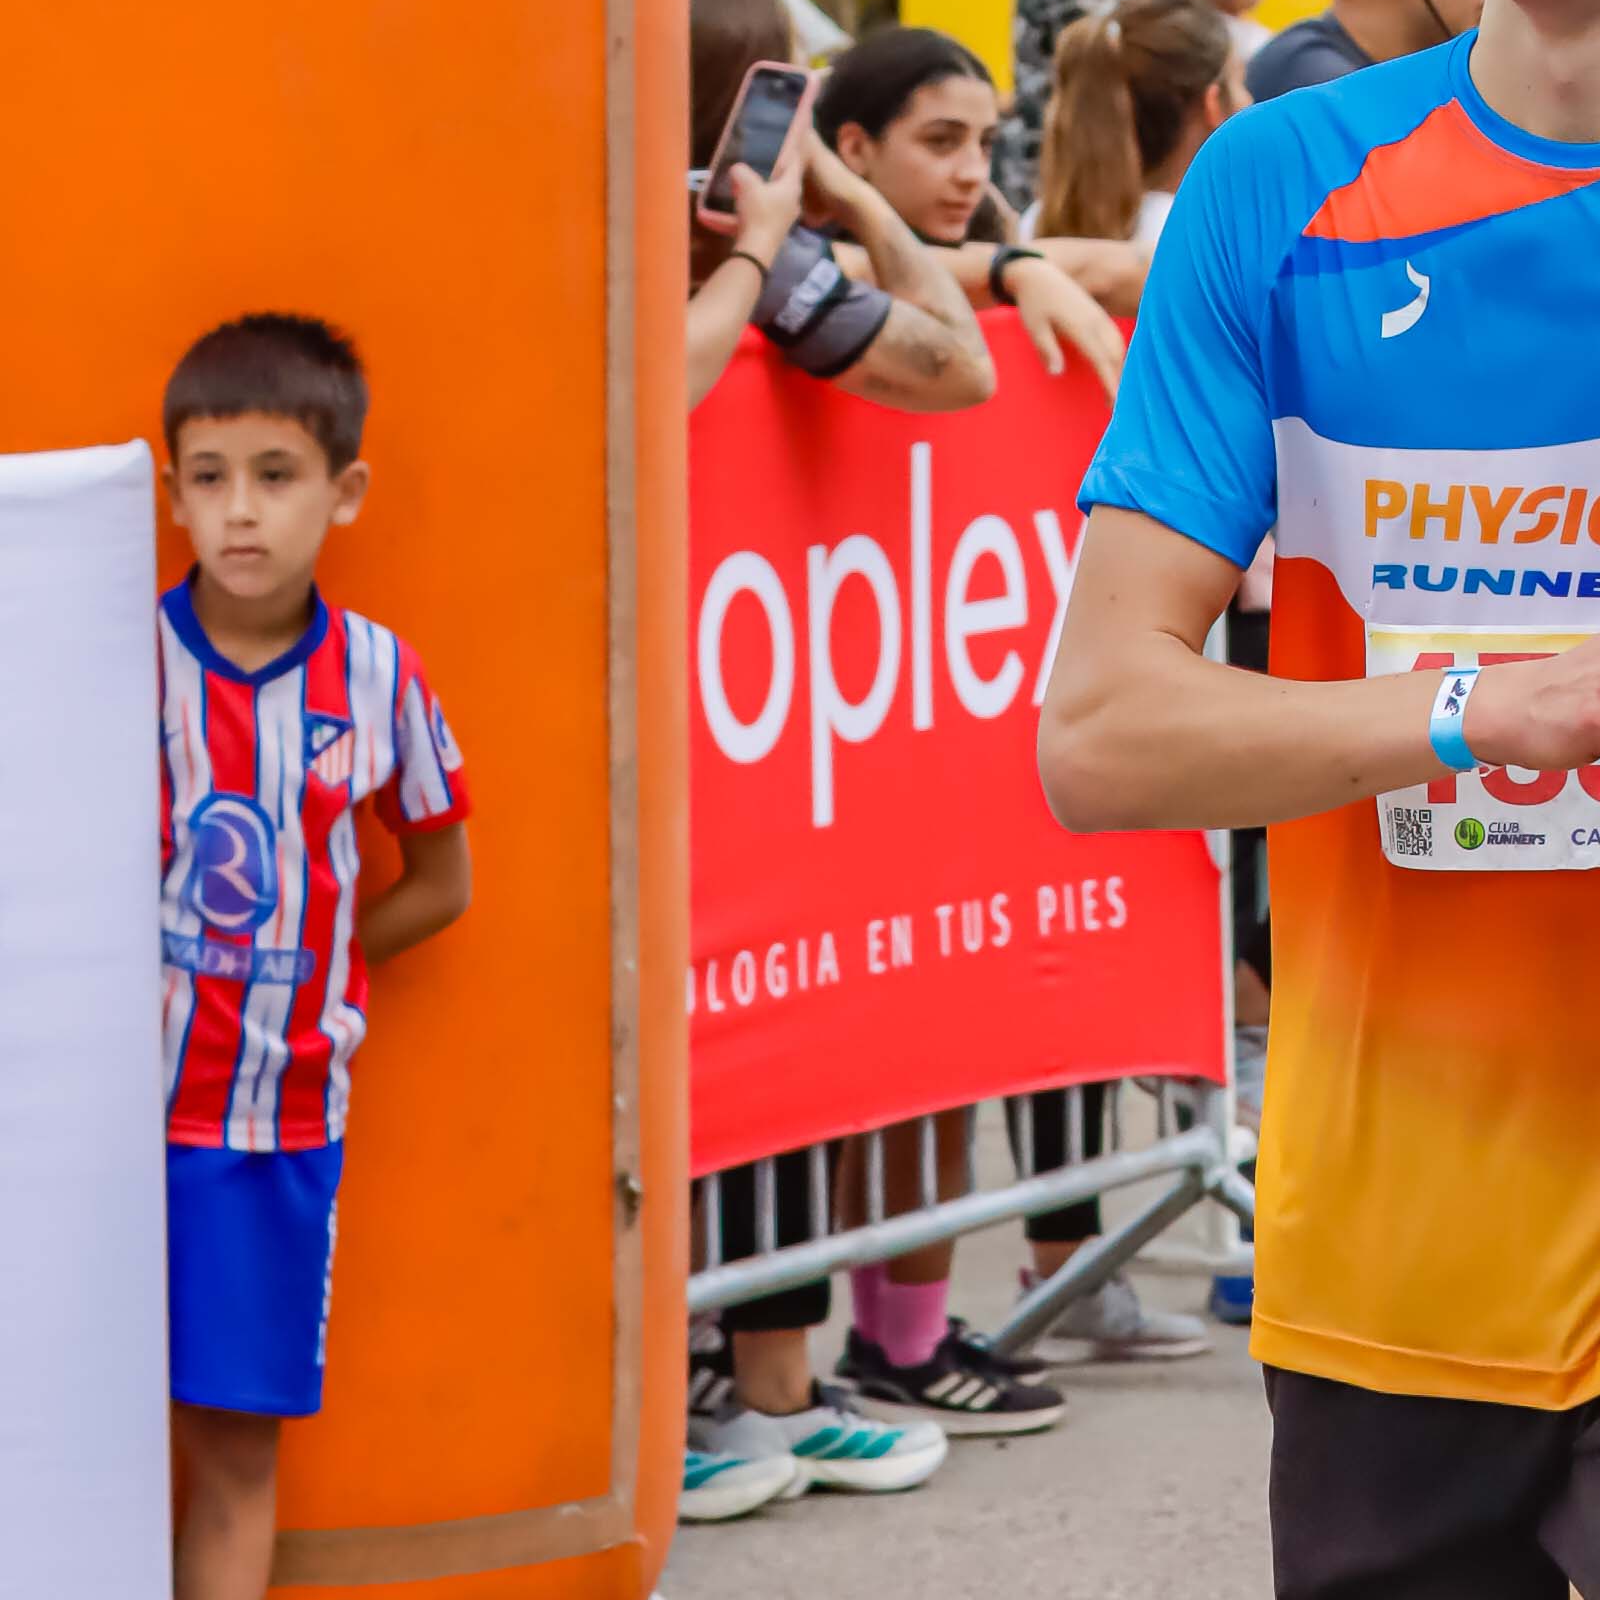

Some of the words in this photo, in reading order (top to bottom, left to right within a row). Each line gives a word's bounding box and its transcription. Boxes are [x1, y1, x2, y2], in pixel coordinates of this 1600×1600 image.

[1488, 822, 1520, 834] CLUB
[867, 914, 913, 974] EN
[935, 892, 1012, 957] TUS
[1037, 875, 1127, 937] PIES
